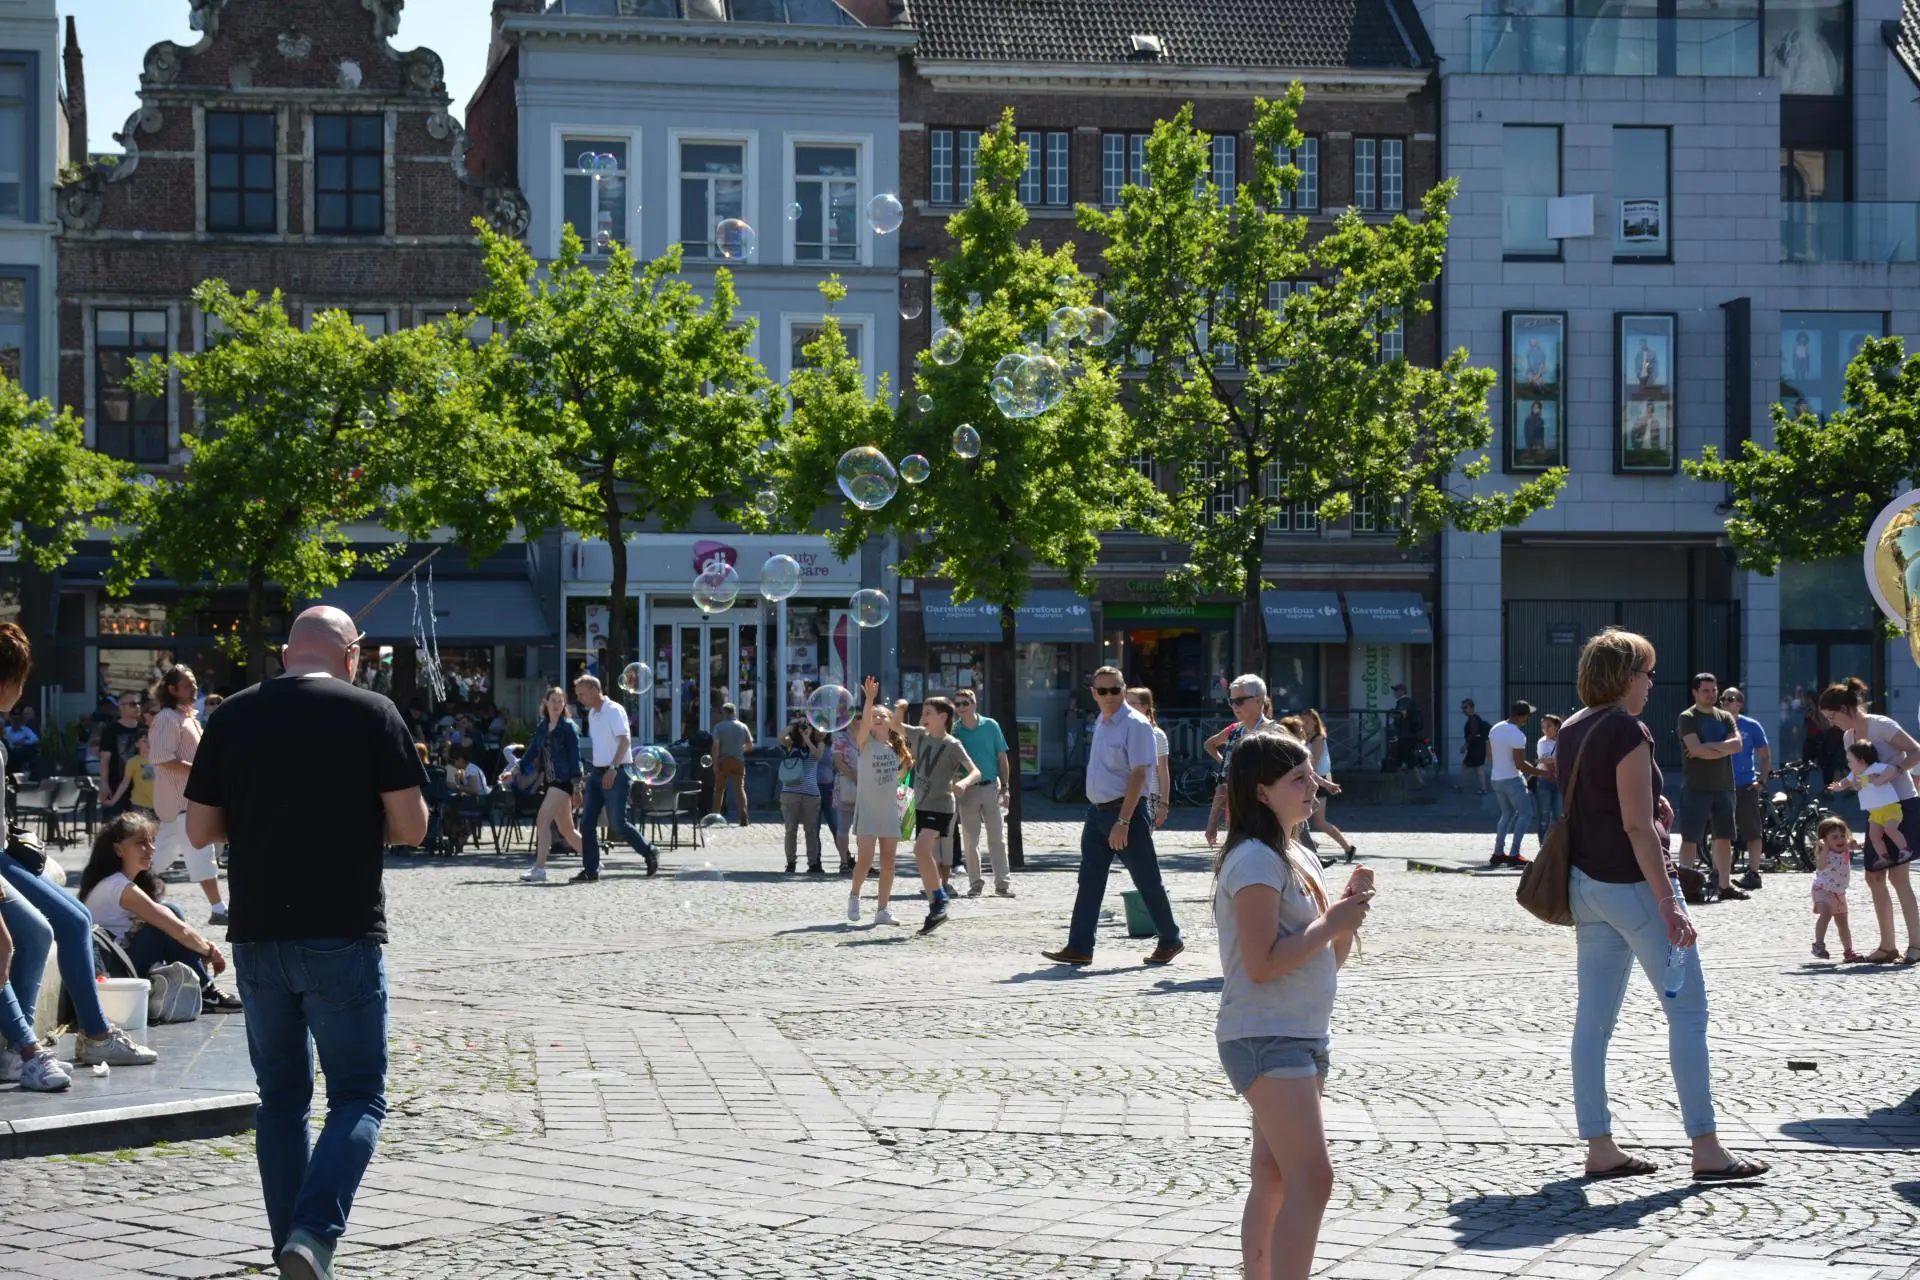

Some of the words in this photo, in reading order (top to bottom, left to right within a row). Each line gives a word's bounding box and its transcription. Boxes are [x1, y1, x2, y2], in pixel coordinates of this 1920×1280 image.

[800, 566, 830, 576] care
[1150, 604, 1195, 615] welkom
[1265, 605, 1315, 614] Carrefour
[1351, 605, 1401, 615] Carrefour
